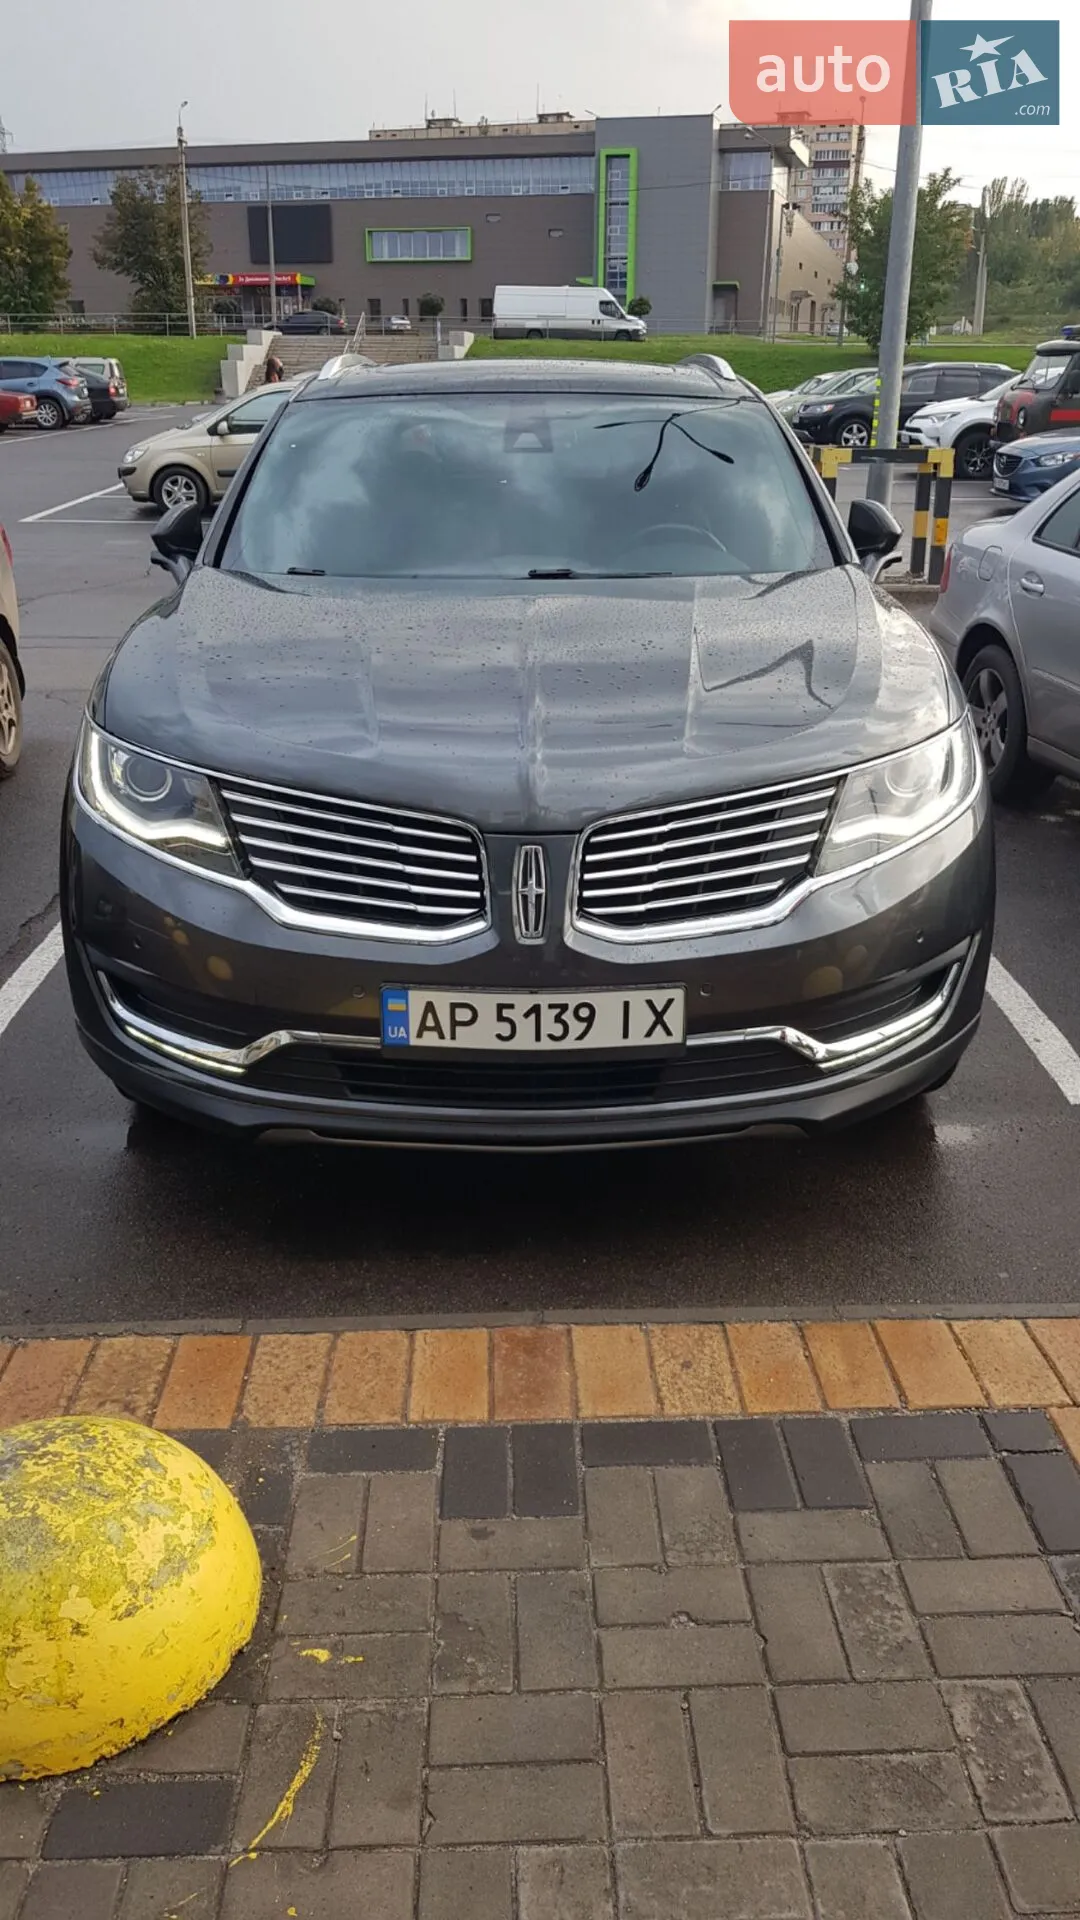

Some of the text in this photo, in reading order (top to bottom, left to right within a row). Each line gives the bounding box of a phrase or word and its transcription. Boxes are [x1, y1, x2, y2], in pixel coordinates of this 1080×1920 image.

[388, 1026, 407, 1038] UA
[416, 998, 676, 1042] AP 5139 IX
